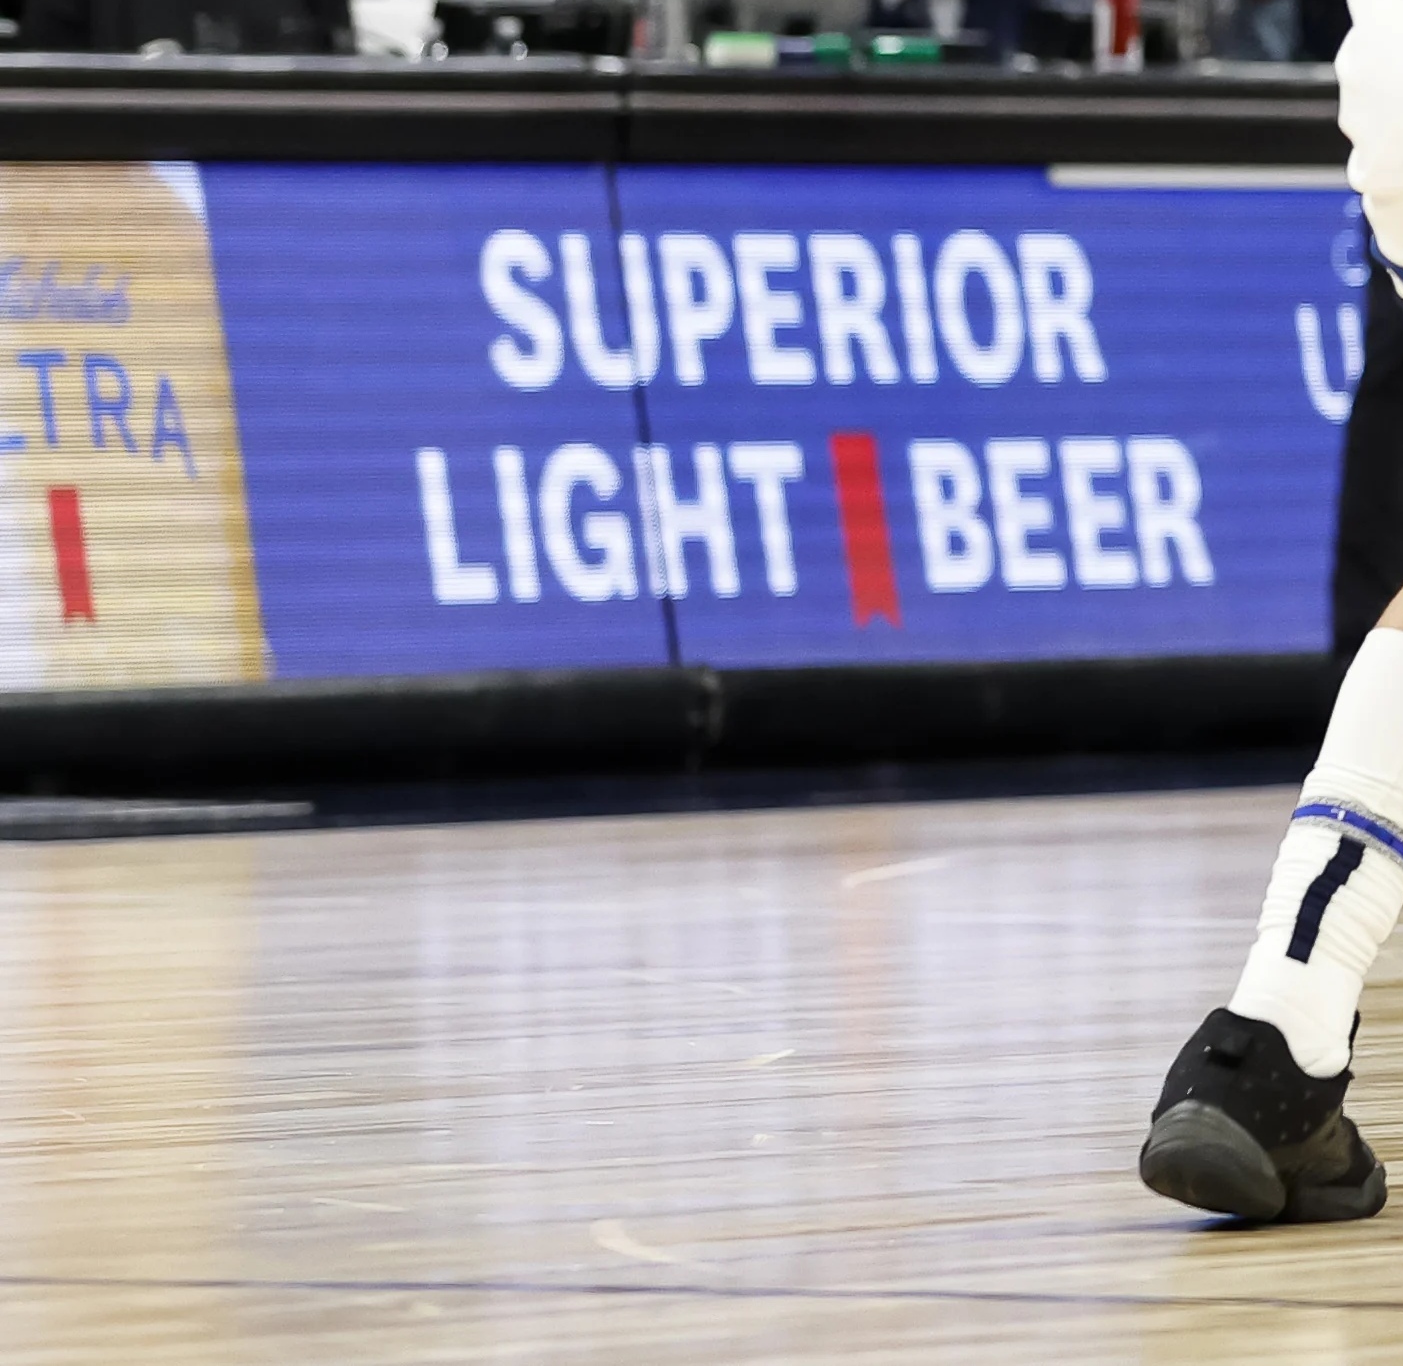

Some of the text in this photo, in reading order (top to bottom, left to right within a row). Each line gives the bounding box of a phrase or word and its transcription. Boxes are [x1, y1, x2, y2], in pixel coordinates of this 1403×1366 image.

[478, 228, 1108, 393] SUPERIOR
[415, 436, 1215, 605] LIGHT BEER
